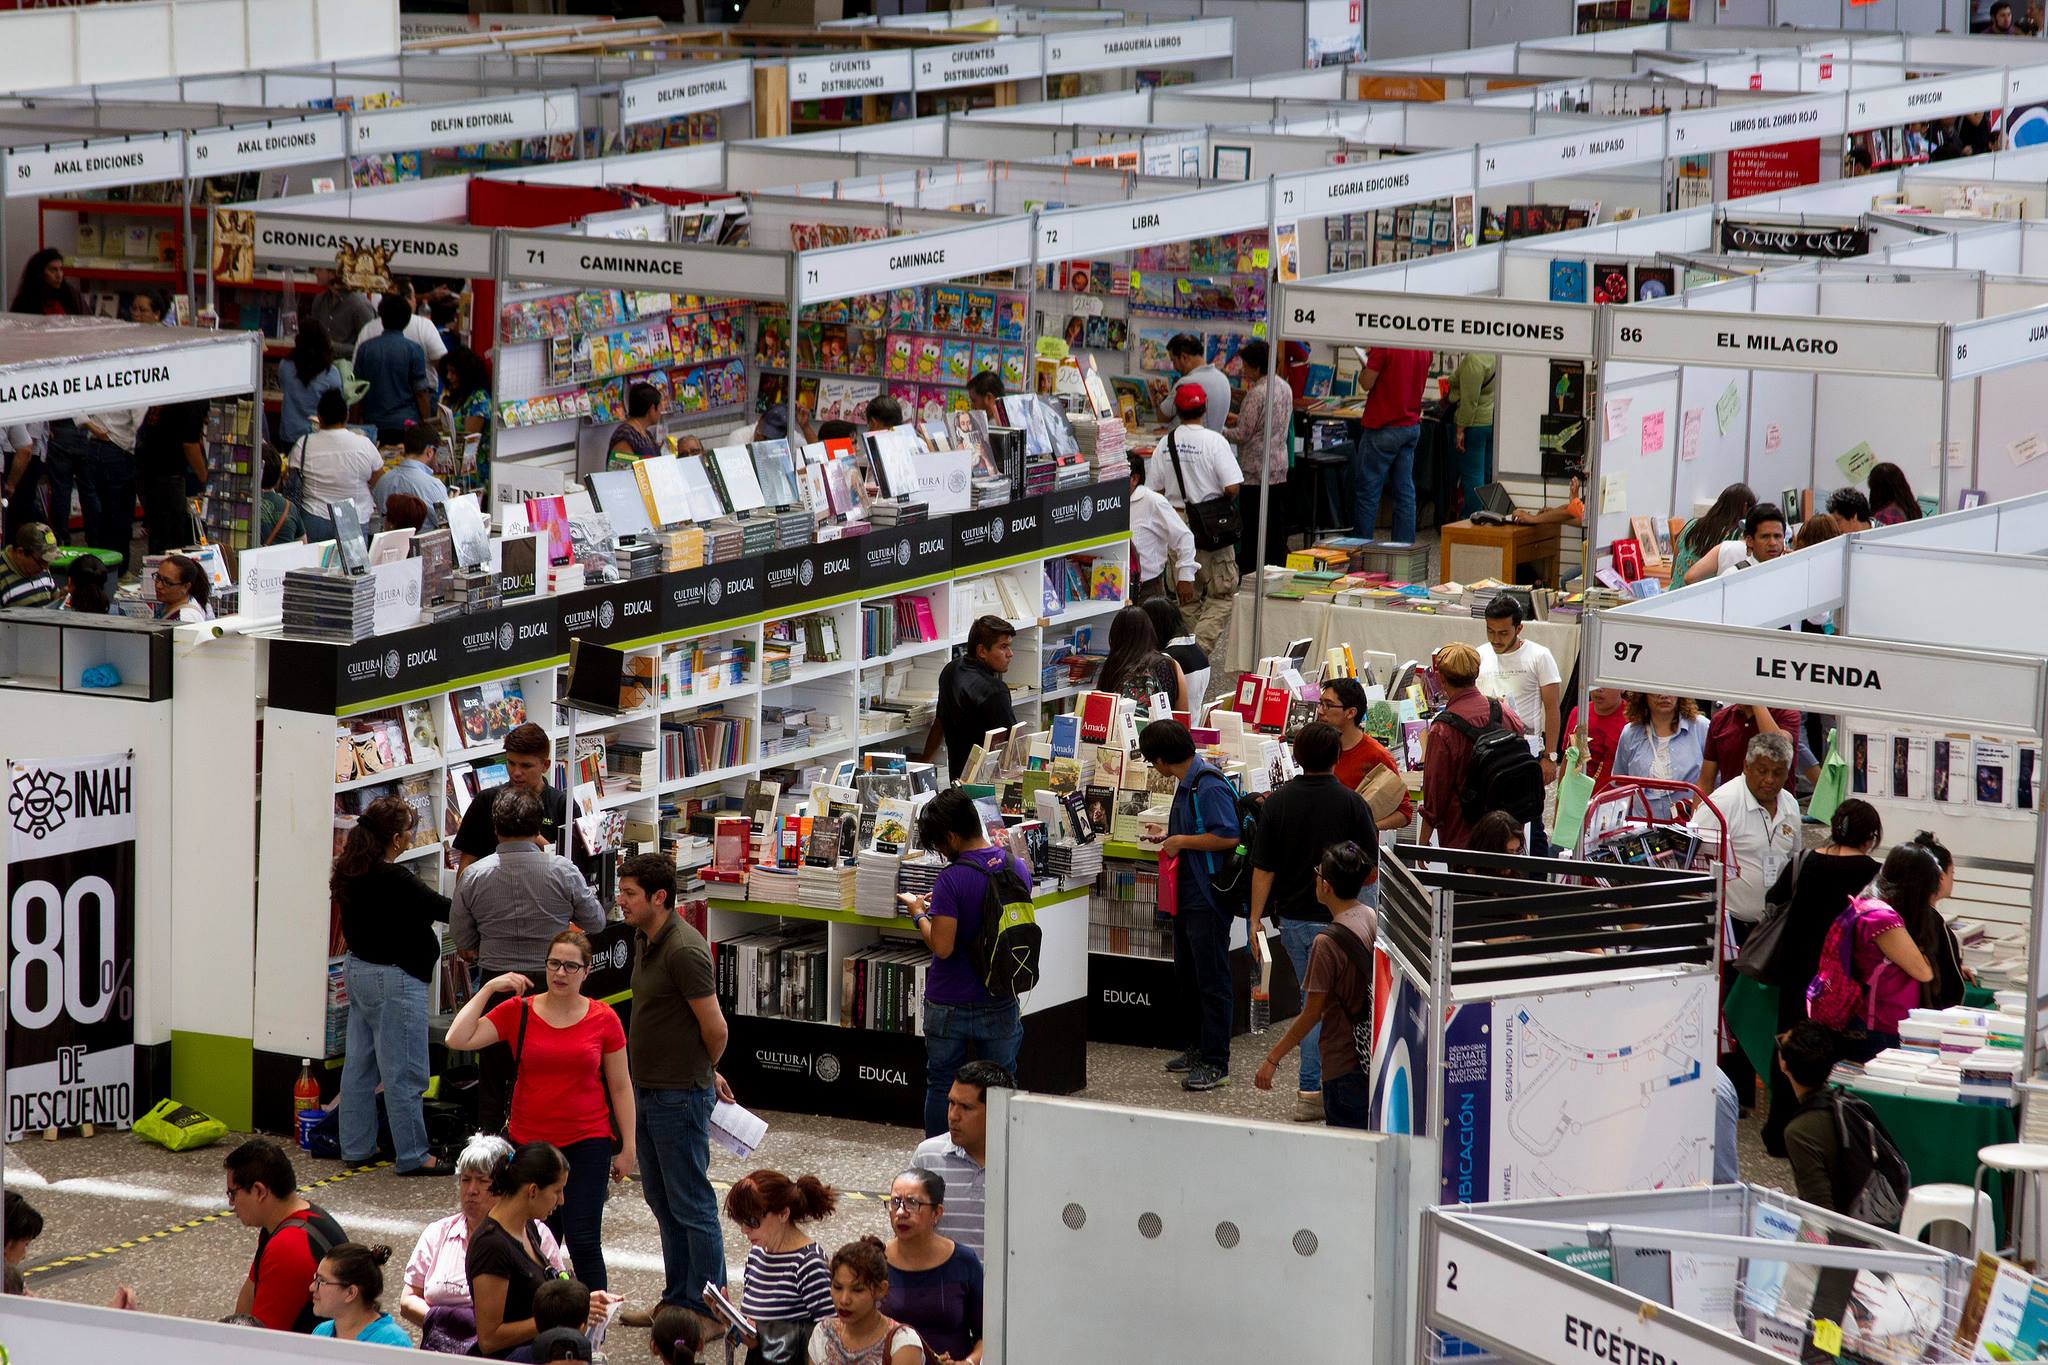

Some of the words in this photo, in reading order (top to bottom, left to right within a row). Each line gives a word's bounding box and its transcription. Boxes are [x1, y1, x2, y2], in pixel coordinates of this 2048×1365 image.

[1104, 36, 1151, 54] TABAQUERÍA
[1154, 36, 1182, 50] LIBROS
[952, 48, 995, 62] CIFUENTES
[1052, 48, 1061, 60] 53
[830, 59, 871, 73] CIFUENTES
[922, 62, 932, 74] 52
[944, 64, 1009, 82] DISTRIBUCIONES
[798, 72, 807, 84] 52
[821, 76, 884, 92] DISTRIBUCIONES
[658, 88, 685, 103] DELFIN
[687, 80, 727, 97] EDITORIAL
[1907, 91, 1943, 107] SEPRECOM
[627, 96, 636, 107] 51
[1858, 103, 1866, 114] 76
[431, 114, 464, 132] DELFIN
[466, 112, 514, 129] EDITORIAL
[1729, 117, 1756, 132] LIBROS
[1757, 115, 1772, 129] DEL
[1772, 112, 1798, 127] ZORRO
[1799, 110, 1818, 124] ROJO
[359, 127, 371, 139] 51
[1676, 128, 1685, 140] 75
[237, 139, 262, 154] AKAL
[265, 133, 316, 149] EDICIONES
[1561, 145, 1576, 159] JUS
[1589, 138, 1625, 155] MALPASO
[197, 146, 208, 159] 50
[1733, 150, 1758, 159] Premio
[1759, 150, 1789, 159] Nacional
[18, 165, 31, 178] 50
[54, 157, 83, 175] AKAL
[86, 153, 144, 171] EDICIONES
[1486, 158, 1495, 171] 74
[1732, 169, 1753, 177] Labor
[1754, 169, 1783, 178] Editorial
[1328, 179, 1364, 197] LEGARIA
[1366, 174, 1409, 192] EDICIONES
[1283, 191, 1293, 204] 73
[1132, 213, 1160, 230] LIBRA
[262, 229, 348, 250] CRONICAS
[369, 236, 459, 257] LEYENDAS
[1046, 230, 1058, 244] 72
[527, 250, 545, 265] 71
[580, 256, 683, 275] CAMINNACE
[889, 249, 945, 270] CAMINNACE
[807, 270, 819, 284] 71
[1294, 309, 1316, 324] 84
[1355, 312, 1455, 333] TECOLOTE
[1461, 319, 1564, 340] EDICIONES
[1620, 328, 1642, 343] 86
[1716, 333, 1740, 349] EL
[1747, 334, 1838, 354] MILAGRO
[1957, 344, 1967, 360] 86
[0, 386, 18, 403] LA
[22, 380, 59, 400] CASA
[63, 377, 82, 395] DE
[85, 375, 102, 391] LA
[106, 366, 170, 388] LECTURA
[1052, 503, 1078, 520] CULTURA
[1097, 496, 1121, 513] EDUCAL
[1012, 515, 1036, 532] EDUCAL
[961, 525, 988, 541] CULTURA
[868, 546, 895, 562] CULTURA
[919, 538, 944, 555] EDUCAL
[767, 566, 797, 582] CULTURA
[823, 559, 850, 575] EDUCAL
[261, 576, 285, 589] CULTU
[502, 573, 535, 591] EDUCAL
[727, 577, 754, 595] EDUCAL
[376, 588, 401, 601] ULTURA
[674, 585, 704, 602] CULTURA
[623, 600, 652, 617] EDUCAL
[564, 610, 595, 626] CULTURA
[463, 631, 495, 647] CULTURA
[519, 622, 548, 640] EDUCAL
[407, 648, 437, 667] EDUCAL
[1614, 641, 1643, 663] 97
[348, 659, 380, 675] CULTURA
[1755, 657, 1882, 690] LEYENDA
[1083, 723, 1107, 733] Amado
[1051, 744, 1074, 754] Amado
[75, 767, 131, 819] INAH
[1103, 990, 1151, 1006] EDUCAL
[1505, 1015, 1513, 1046] NIVEL
[756, 1050, 807, 1066] CULTURA
[1449, 1050, 1486, 1060] REMATE
[58, 1046, 86, 1086] DE
[859, 1066, 908, 1085] EDUCAL
[1449, 1074, 1486, 1083] NACIONAL
[1505, 1048, 1514, 1103] SEGUNDO
[10, 1082, 130, 1132] DESCUENTO
[1503, 1165, 1512, 1195] NIVEL
[1447, 1261, 1458, 1291] 2
